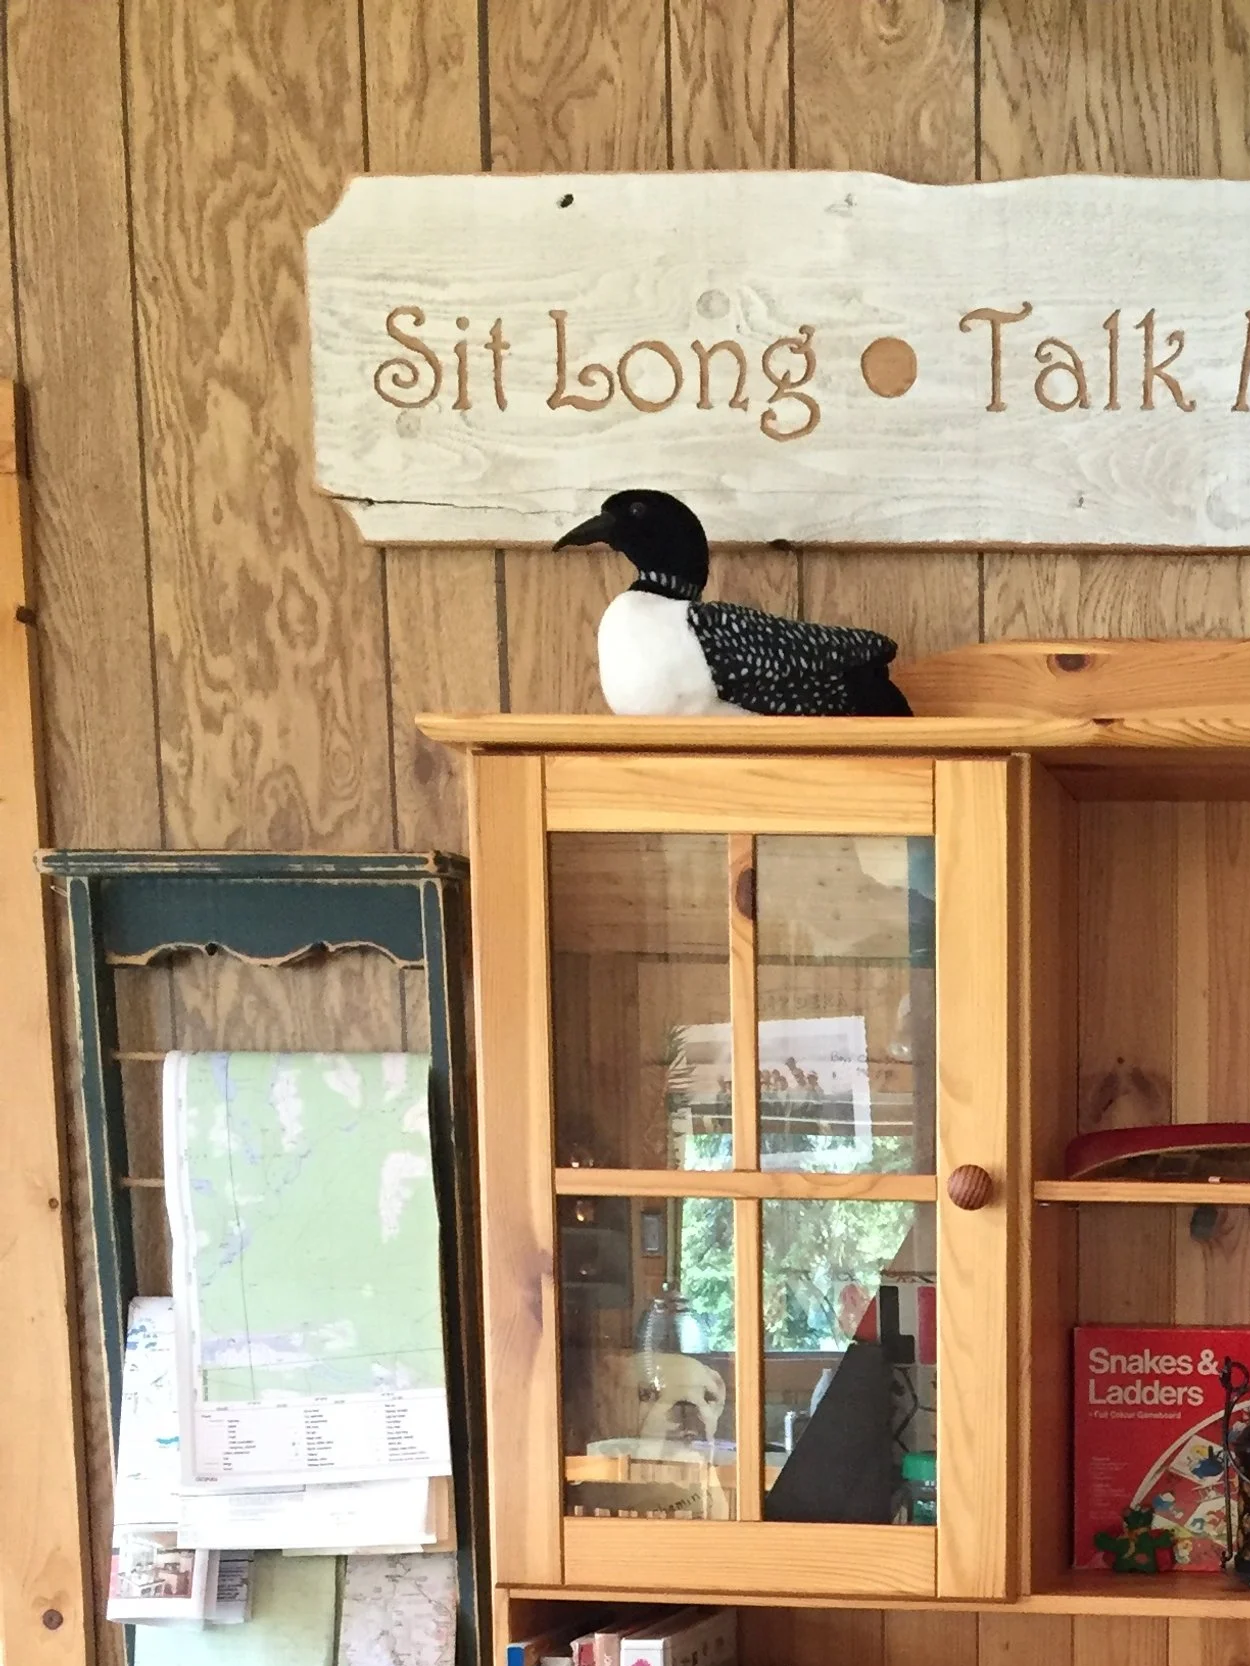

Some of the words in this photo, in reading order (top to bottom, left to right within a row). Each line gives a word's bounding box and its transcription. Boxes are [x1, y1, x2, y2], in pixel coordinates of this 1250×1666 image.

[373, 304, 509, 413] Sit
[547, 308, 822, 442] Long
[959, 300, 1196, 413] Talk
[1089, 1347, 1193, 1375] Snakes
[1197, 1349, 1220, 1376] &
[1088, 1379, 1204, 1407] Ladders
